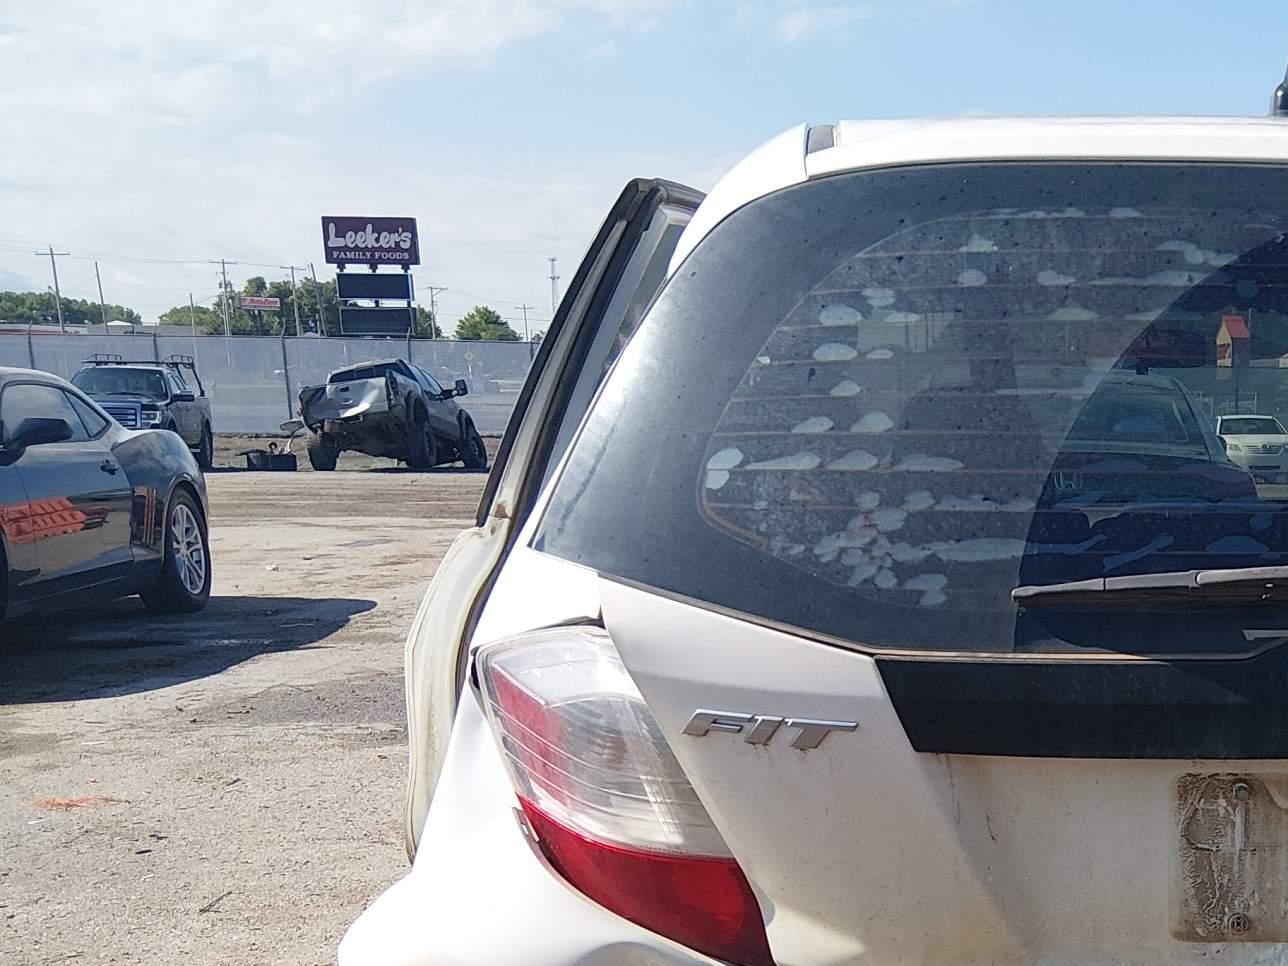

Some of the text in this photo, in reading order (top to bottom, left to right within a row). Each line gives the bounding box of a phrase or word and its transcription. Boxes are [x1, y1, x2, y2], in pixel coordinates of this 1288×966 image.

[327, 222, 412, 249] Leeker's
[332, 251, 410, 260] FAMILY FOODS
[682, 708, 859, 750] FIT
